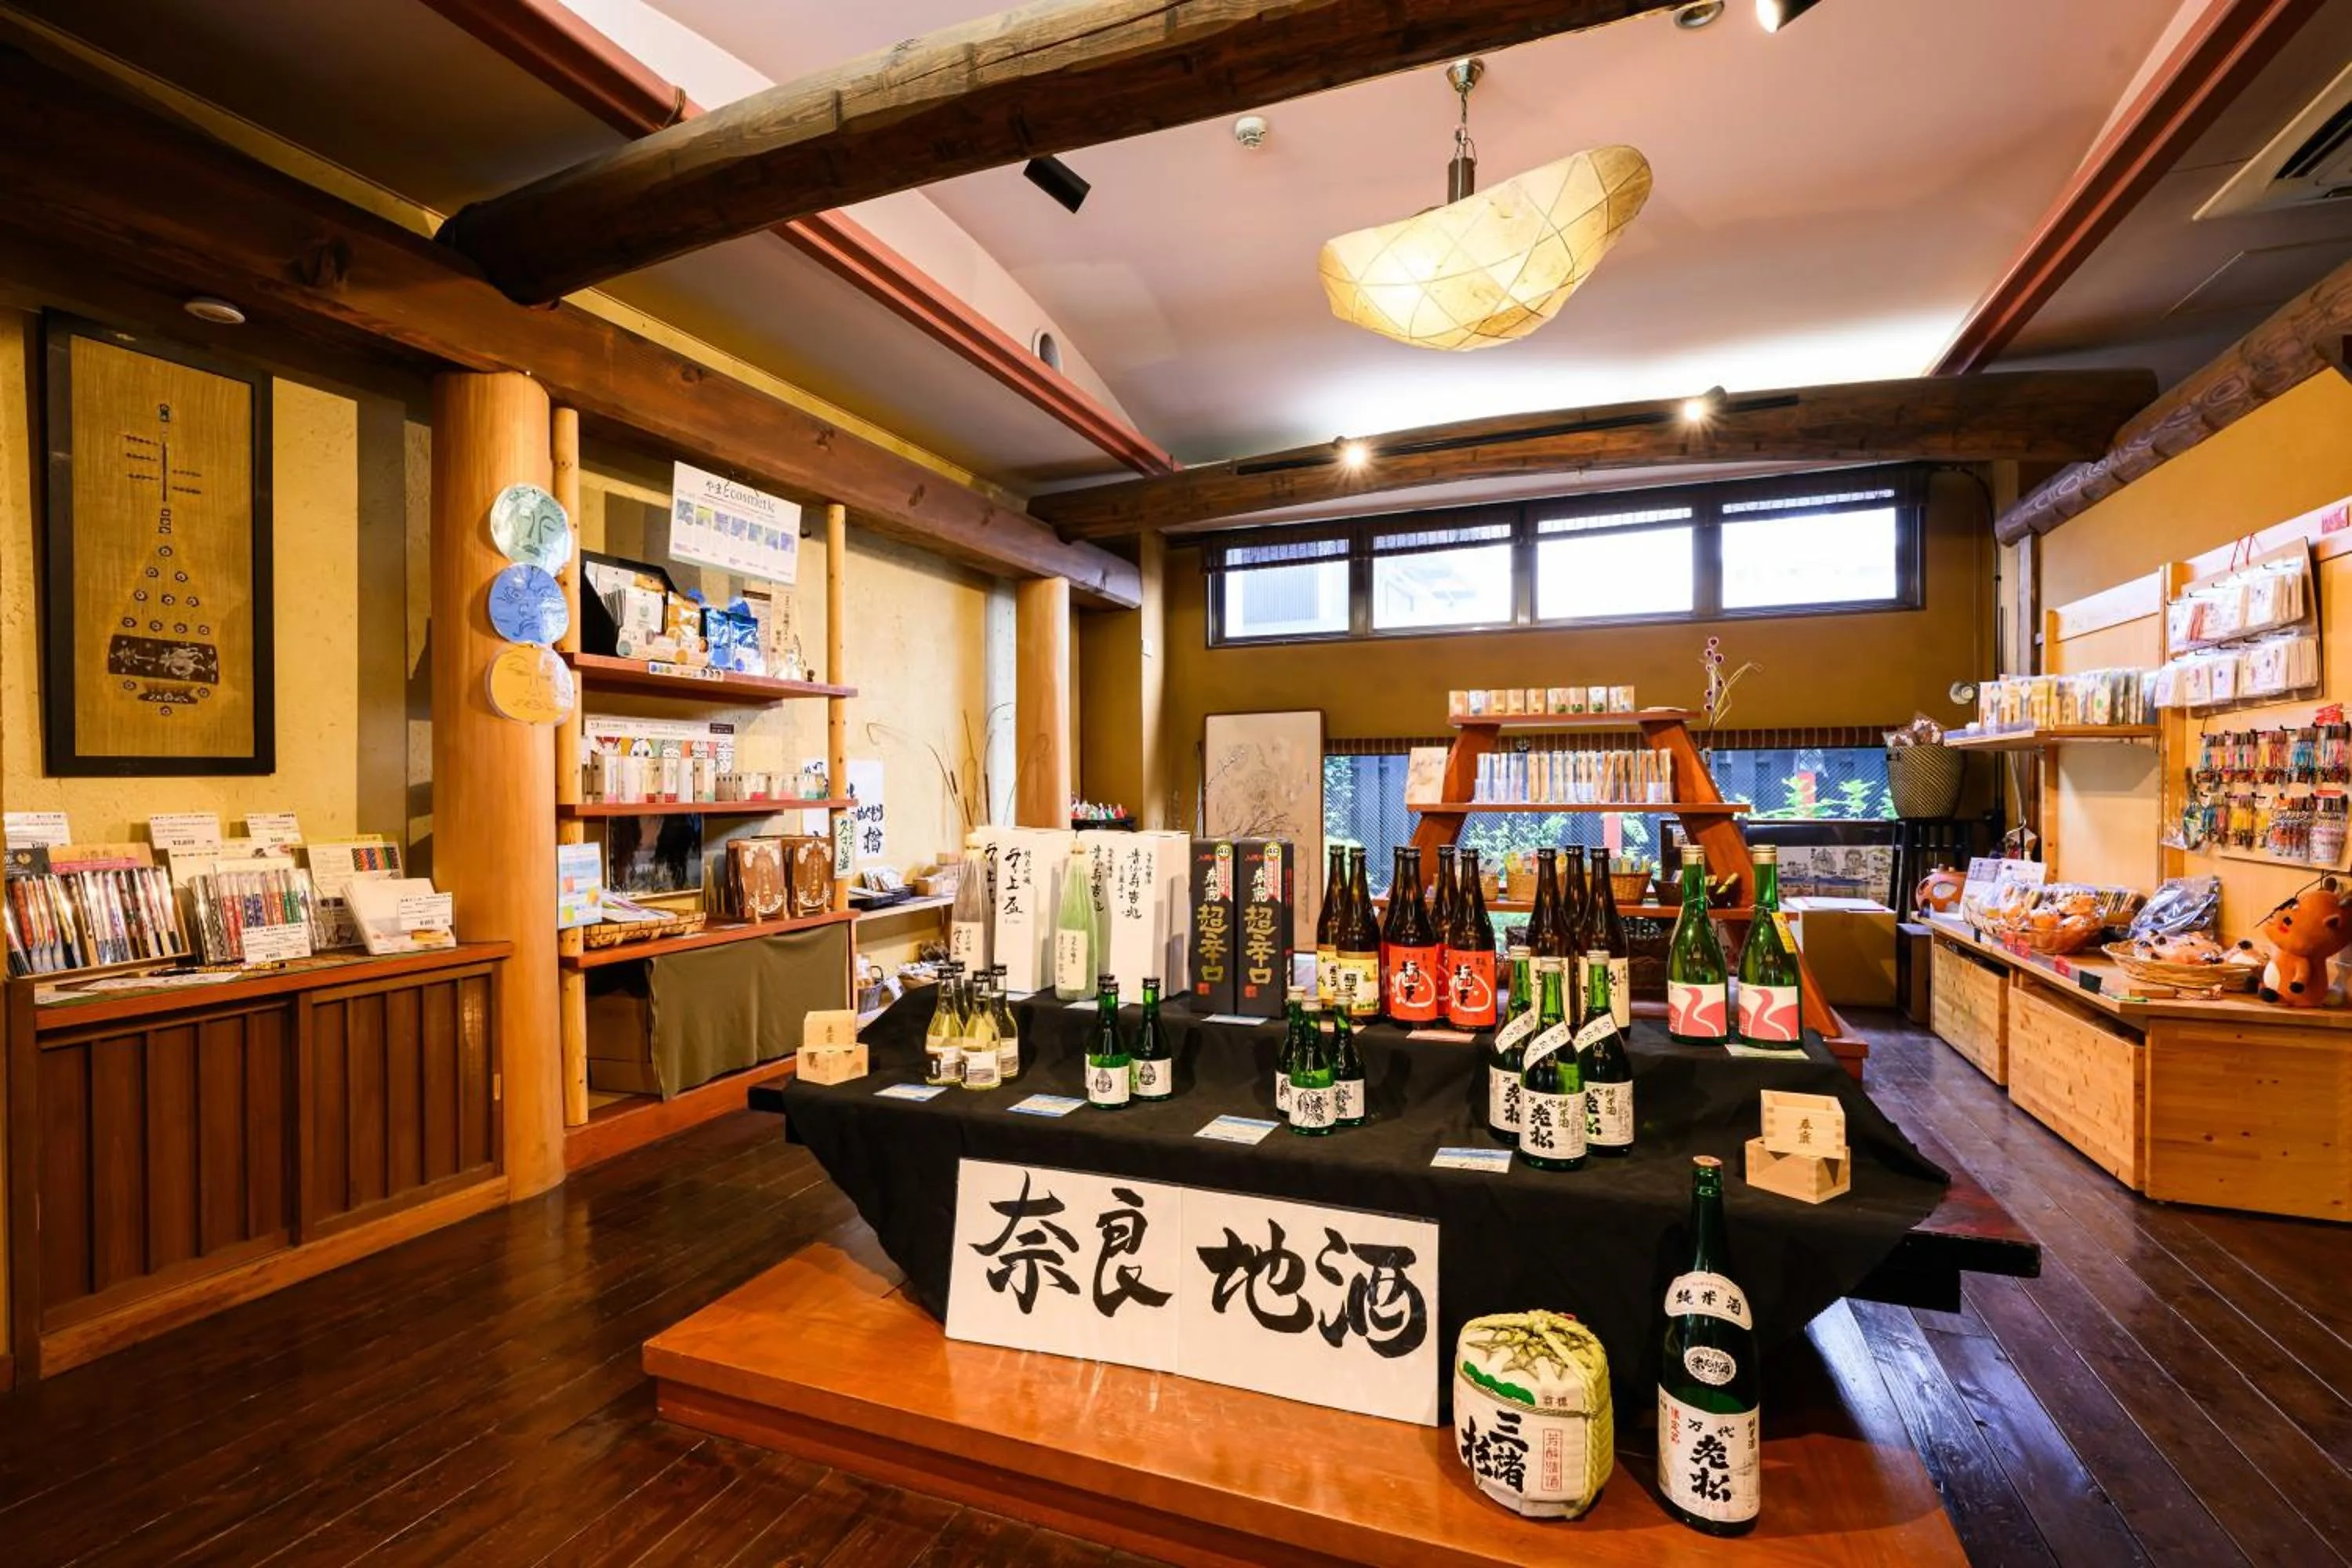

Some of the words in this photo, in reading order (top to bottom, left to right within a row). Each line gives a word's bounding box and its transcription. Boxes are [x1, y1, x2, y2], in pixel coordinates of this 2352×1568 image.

[1243, 904, 1277, 985] 超辛口
[969, 1171, 1428, 1359] 奈良地酒
[1675, 1288, 1742, 1316] 純米酒
